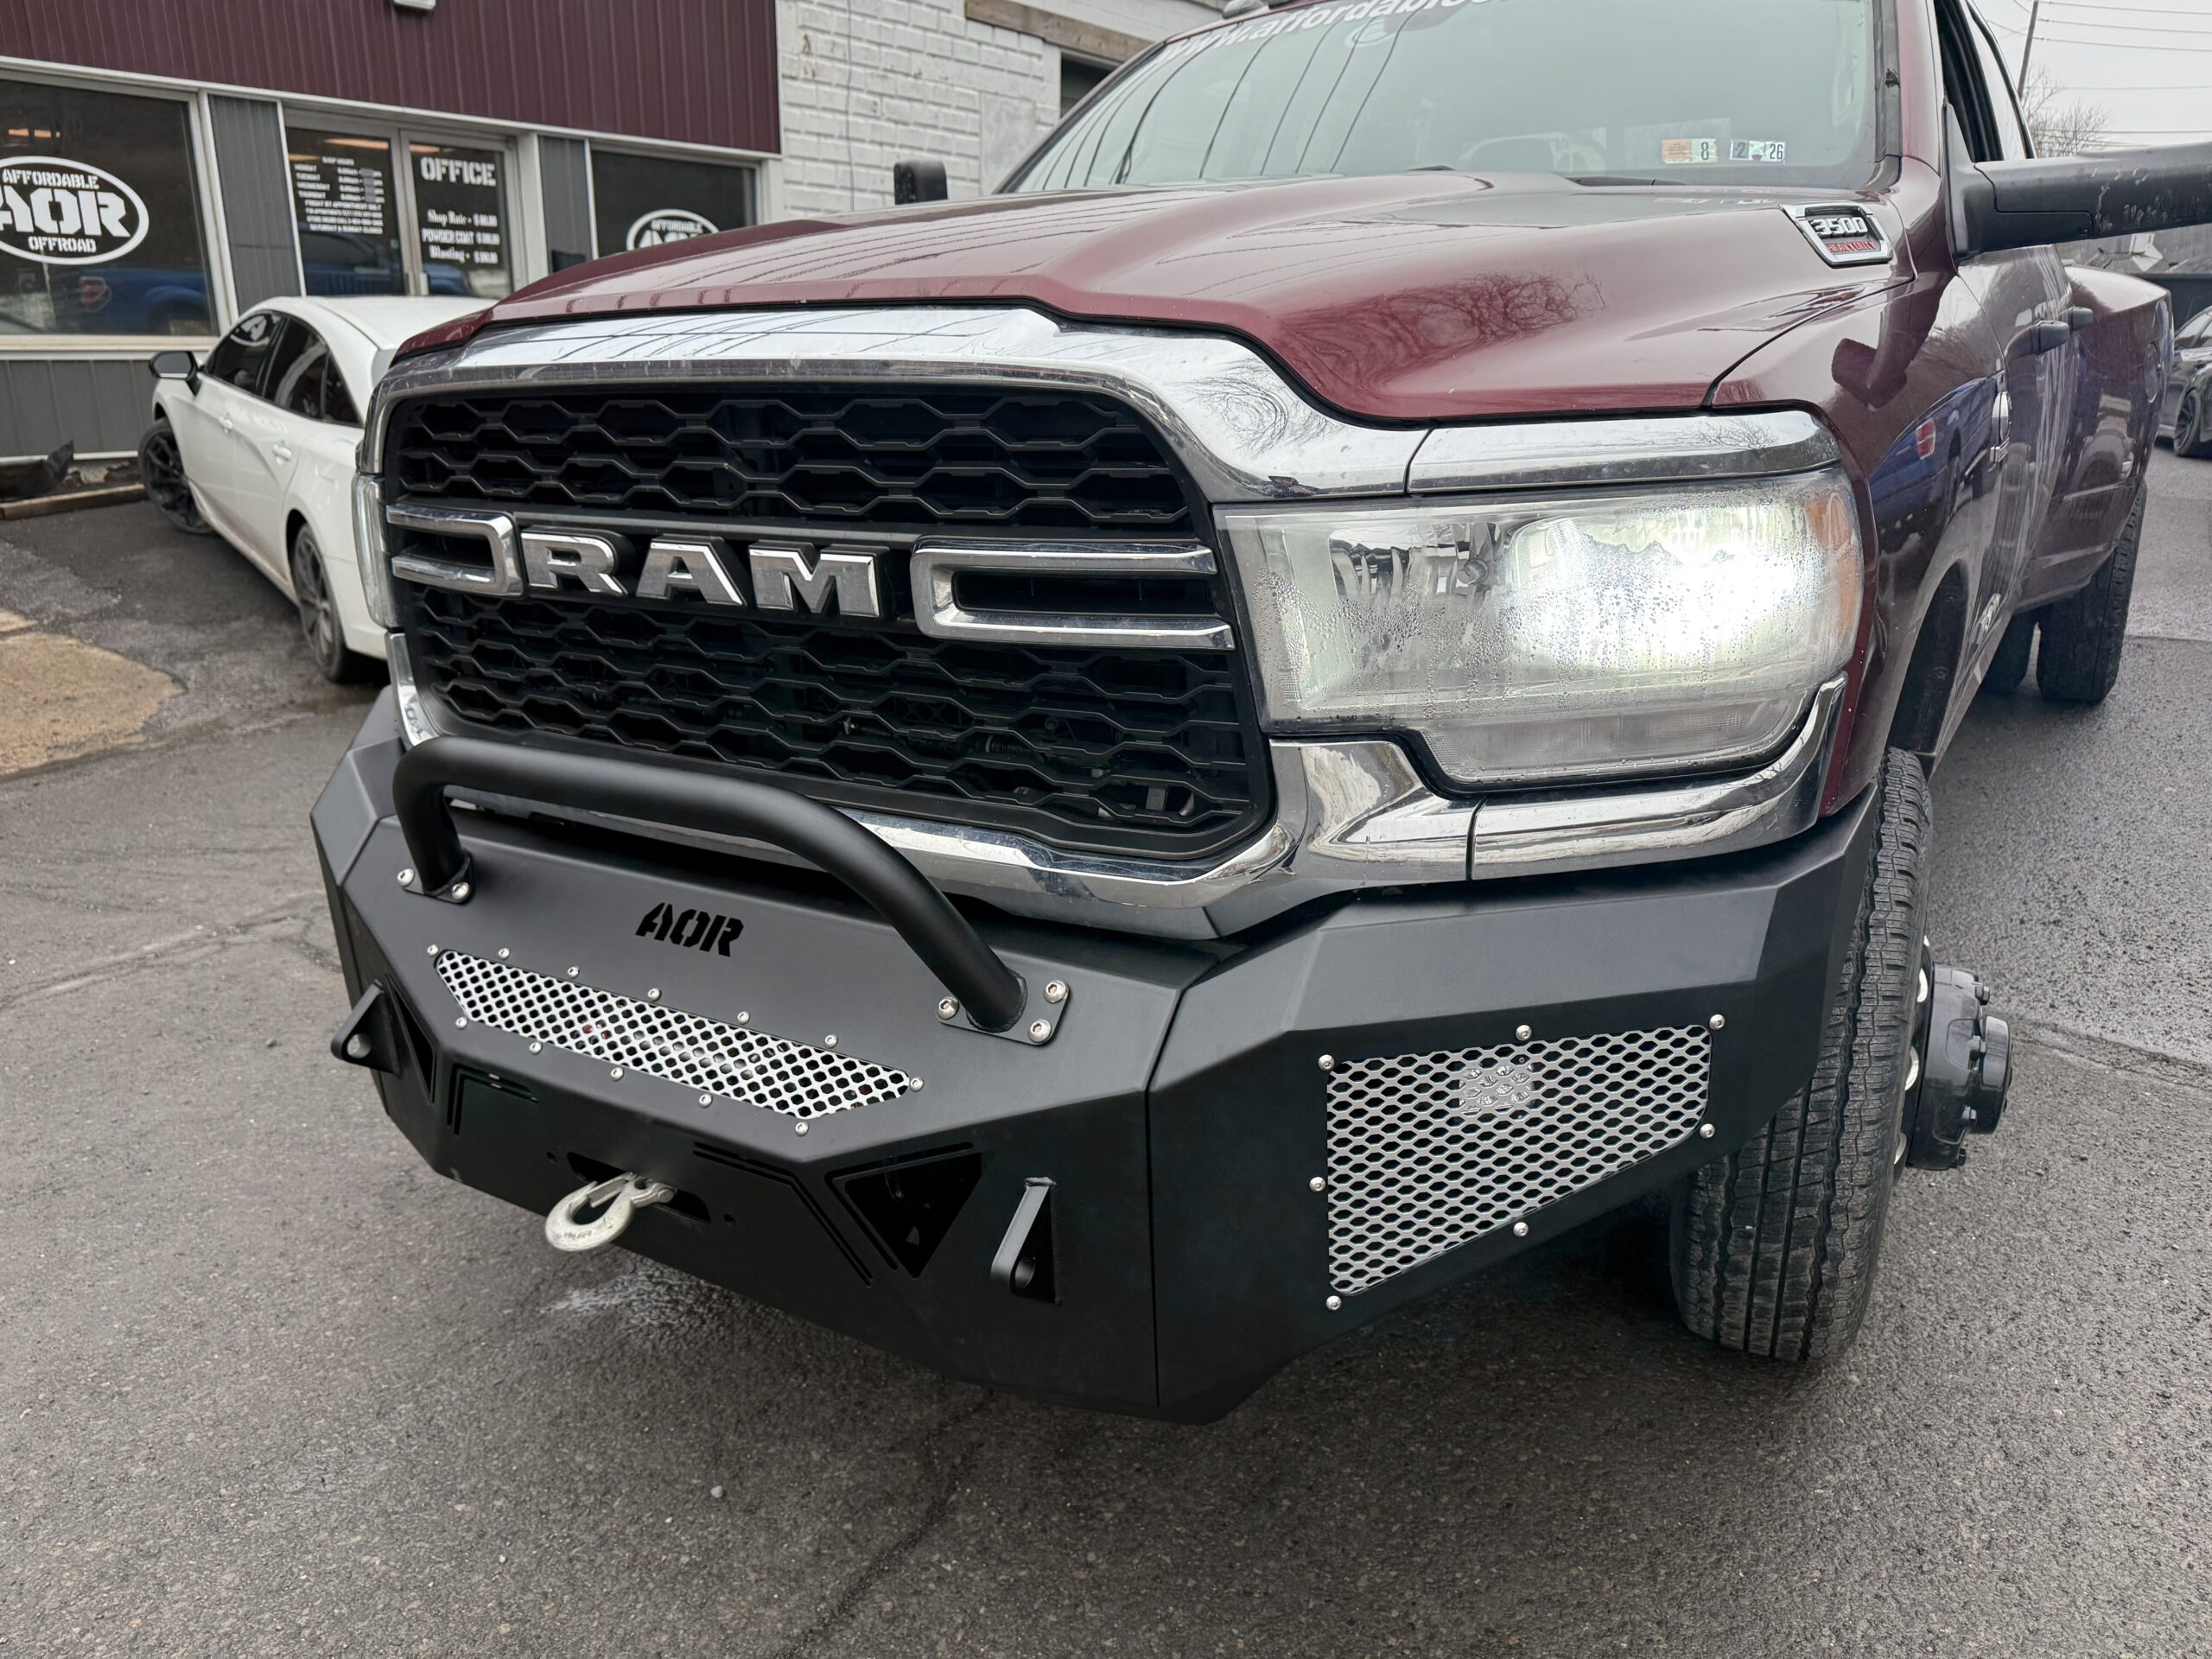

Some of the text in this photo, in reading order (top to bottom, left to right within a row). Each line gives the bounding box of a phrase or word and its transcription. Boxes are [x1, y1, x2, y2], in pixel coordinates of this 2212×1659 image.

[1700, 141, 1710, 161] 8
[1769, 143, 1783, 160] 26
[2, 168, 100, 190] AFFORDABLE
[420, 156, 497, 187] OFFICE
[0, 185, 131, 238] AOR
[1810, 216, 1868, 238] 3500
[28, 235, 97, 253] OFFROAD
[1824, 240, 1877, 253] HEAVY DUTY
[520, 526, 883, 619] RAM
[634, 901, 745, 957] AOR
